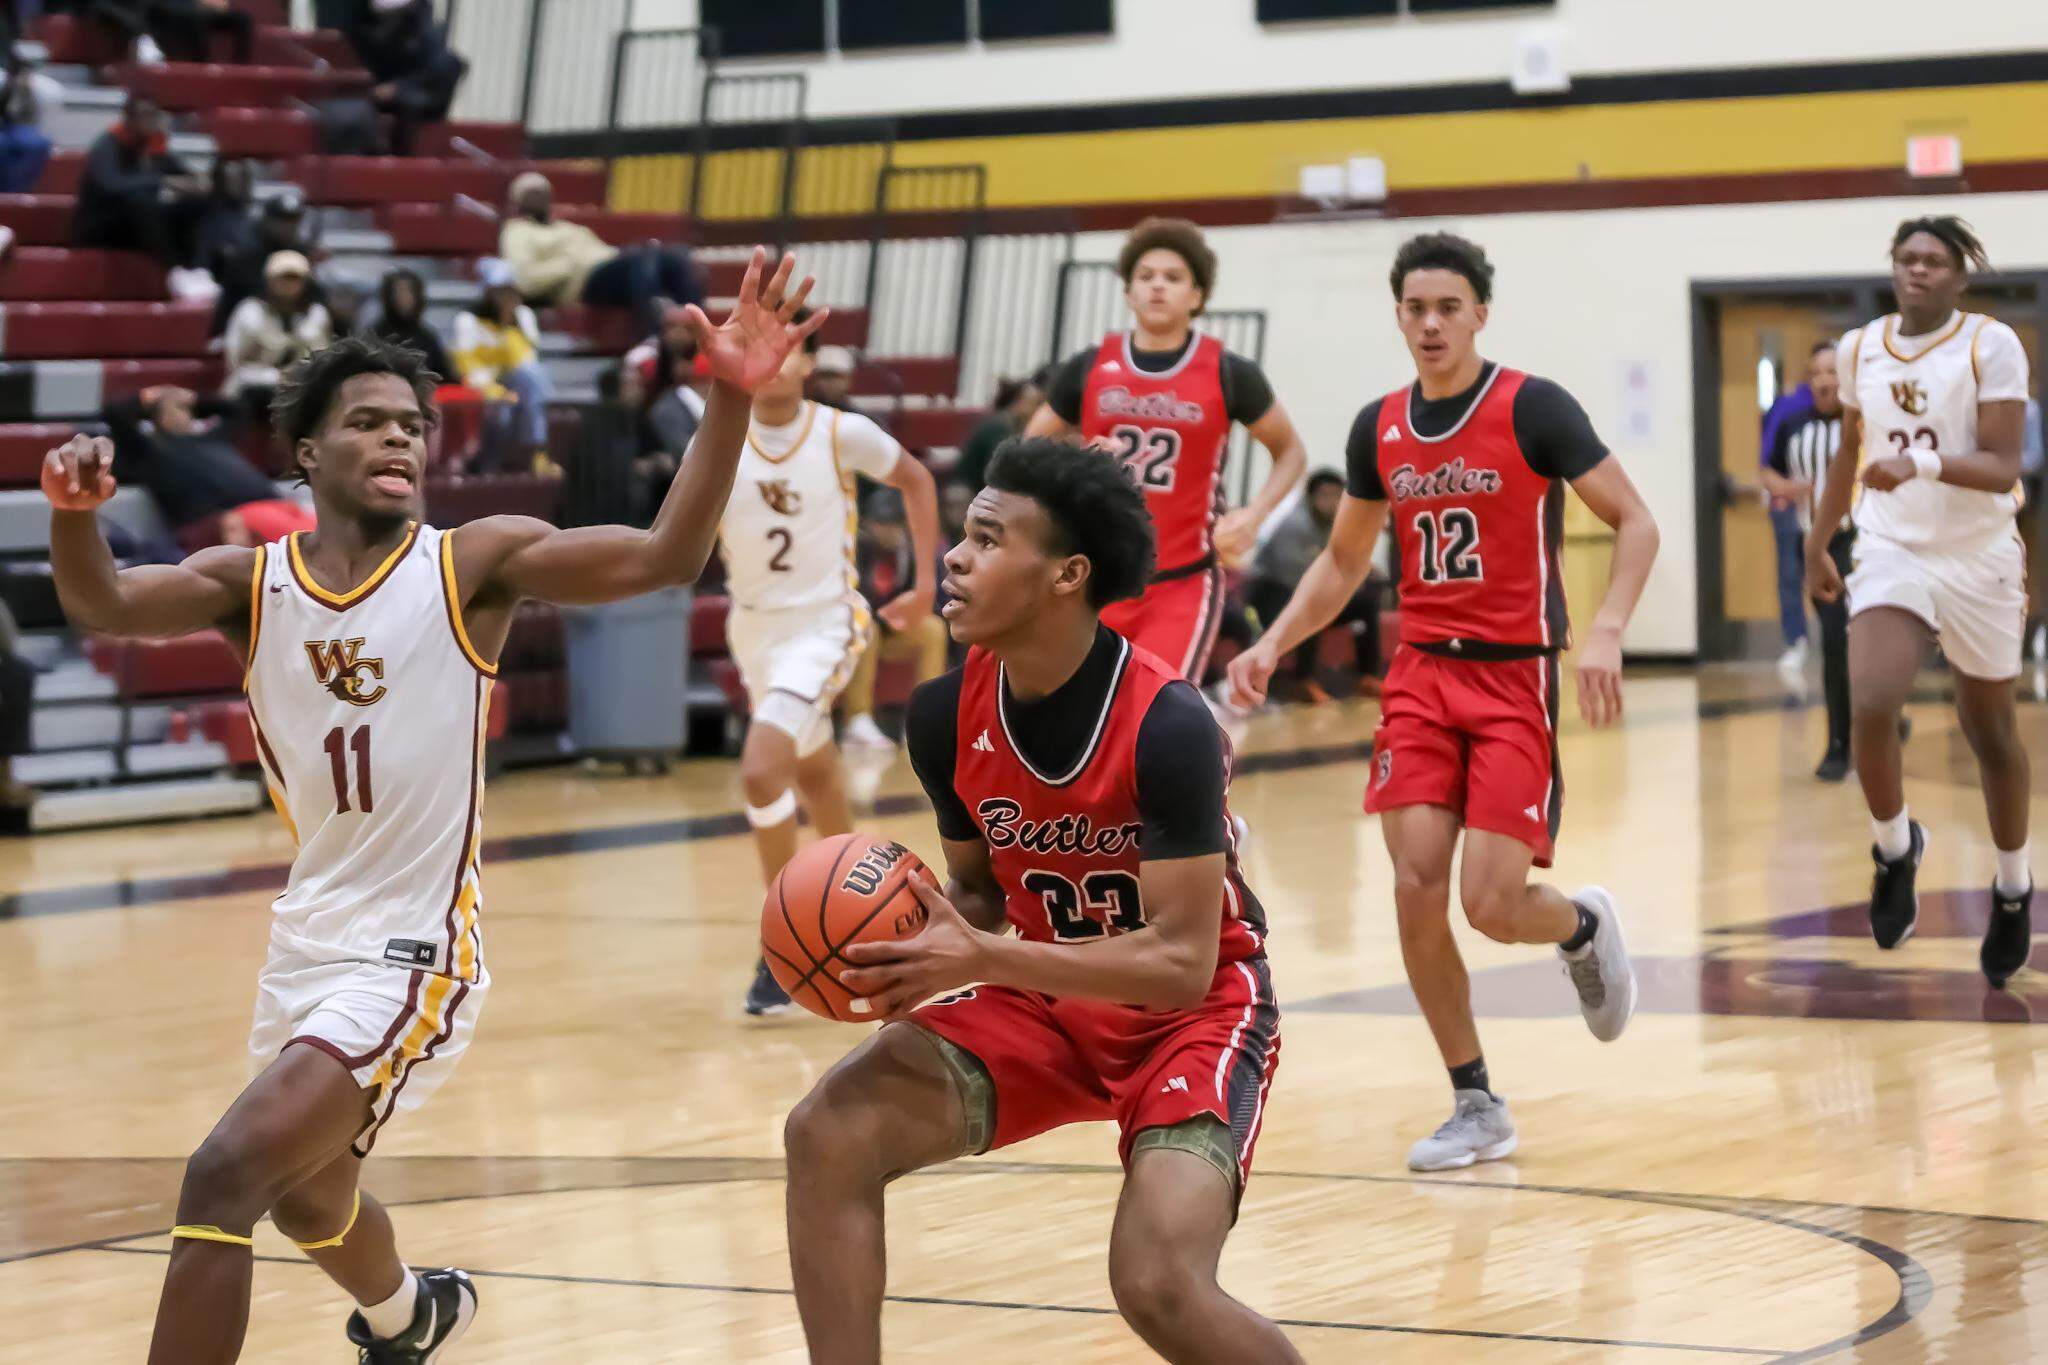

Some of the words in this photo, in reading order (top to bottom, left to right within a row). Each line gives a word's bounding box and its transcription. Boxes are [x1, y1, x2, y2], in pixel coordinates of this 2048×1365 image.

[1390, 456, 1502, 501] Butler
[766, 526, 793, 571] 2
[1413, 507, 1484, 584] 12
[304, 637, 387, 706] WC
[324, 724, 373, 814] 11
[977, 797, 1143, 856] Butler
[1021, 868, 1149, 943] 23
[420, 949, 431, 959] M
